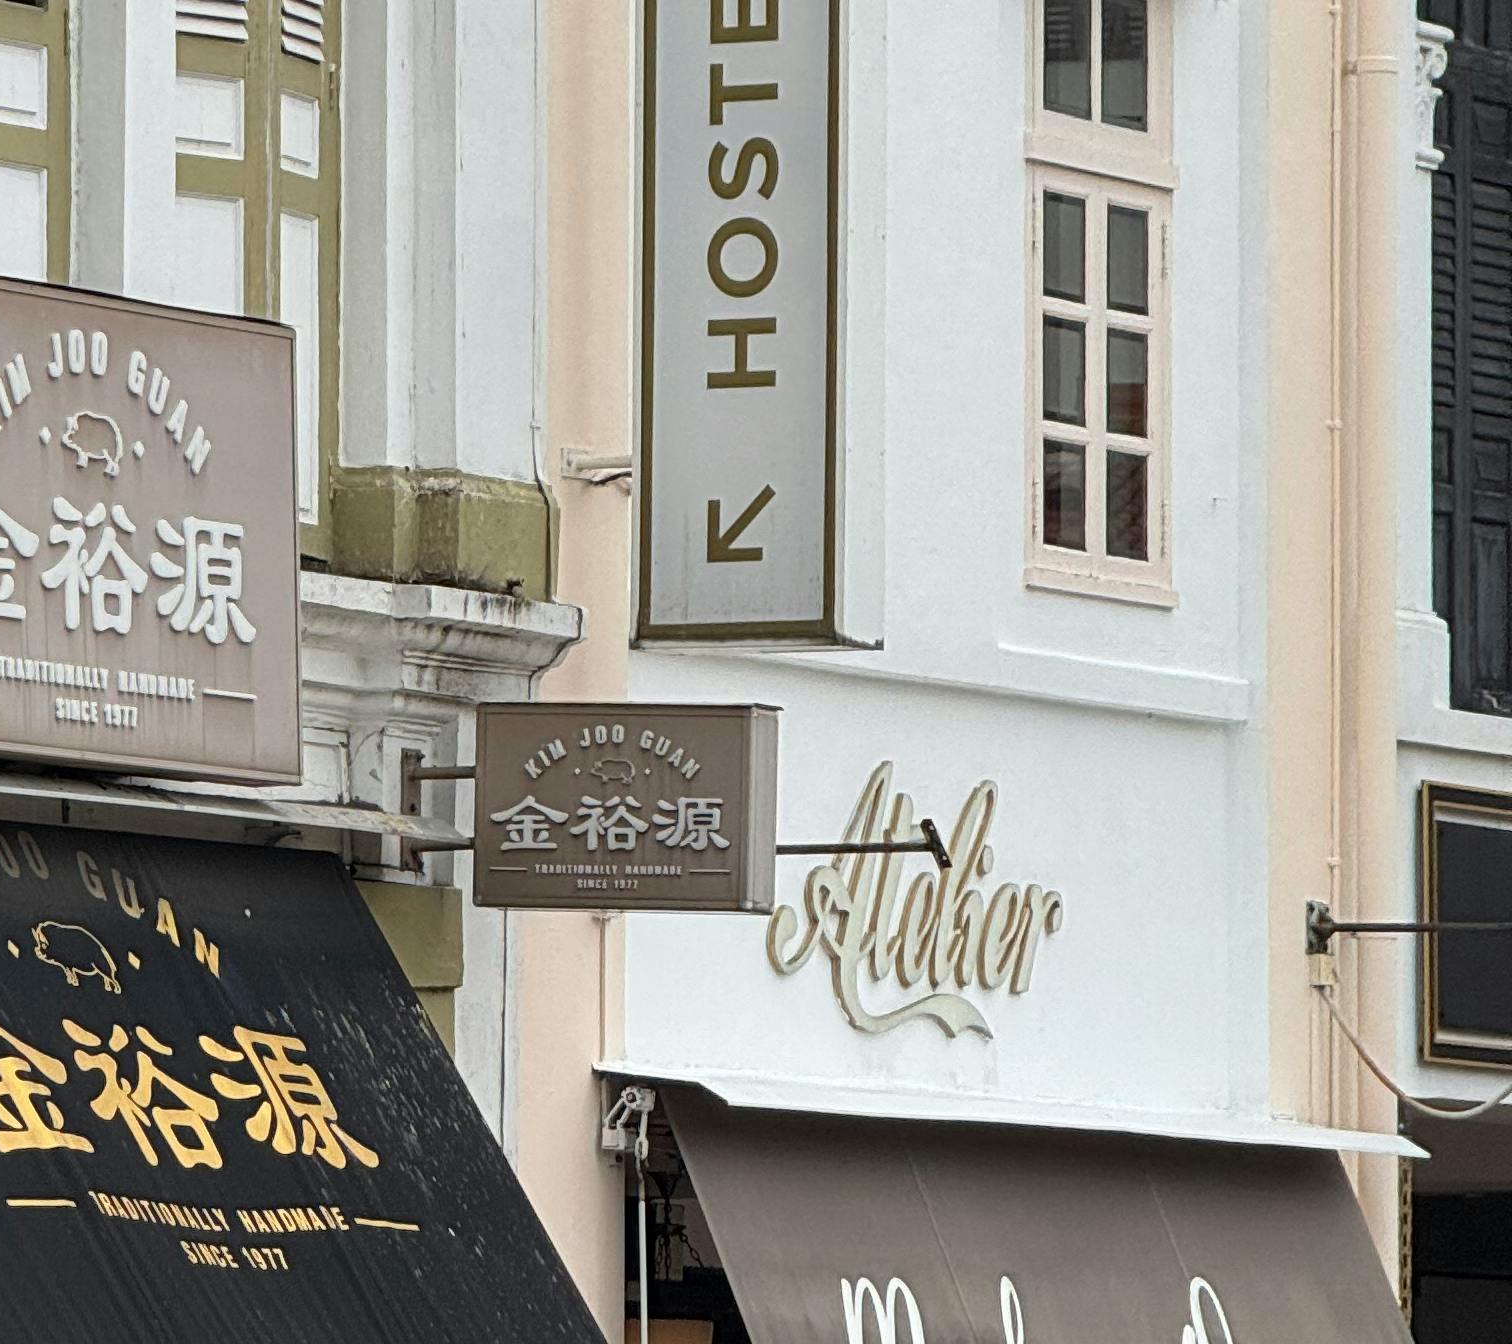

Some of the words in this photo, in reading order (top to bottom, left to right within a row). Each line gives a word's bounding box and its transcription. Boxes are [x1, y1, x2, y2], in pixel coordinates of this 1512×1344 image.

[47, 329, 108, 378] JOO
[127, 350, 212, 476] GUAN
[55, 698, 98, 724] SINCE
[103, 703, 139, 727] 1977
[524, 738, 567, 779] KIM
[579, 724, 625, 748] JOO
[639, 729, 701, 780] GUAN
[489, 795, 730, 851] 金裕源
[577, 878, 608, 890] SINCE
[766, 759, 1063, 1040] Atelier
[76, 849, 220, 980] GUAN
[88, 1191, 230, 1232] TRADITIONALLY
[237, 1205, 350, 1234] HANDMADE
[180, 1240, 239, 1269] SINCE
[242, 1245, 289, 1271] 1977
